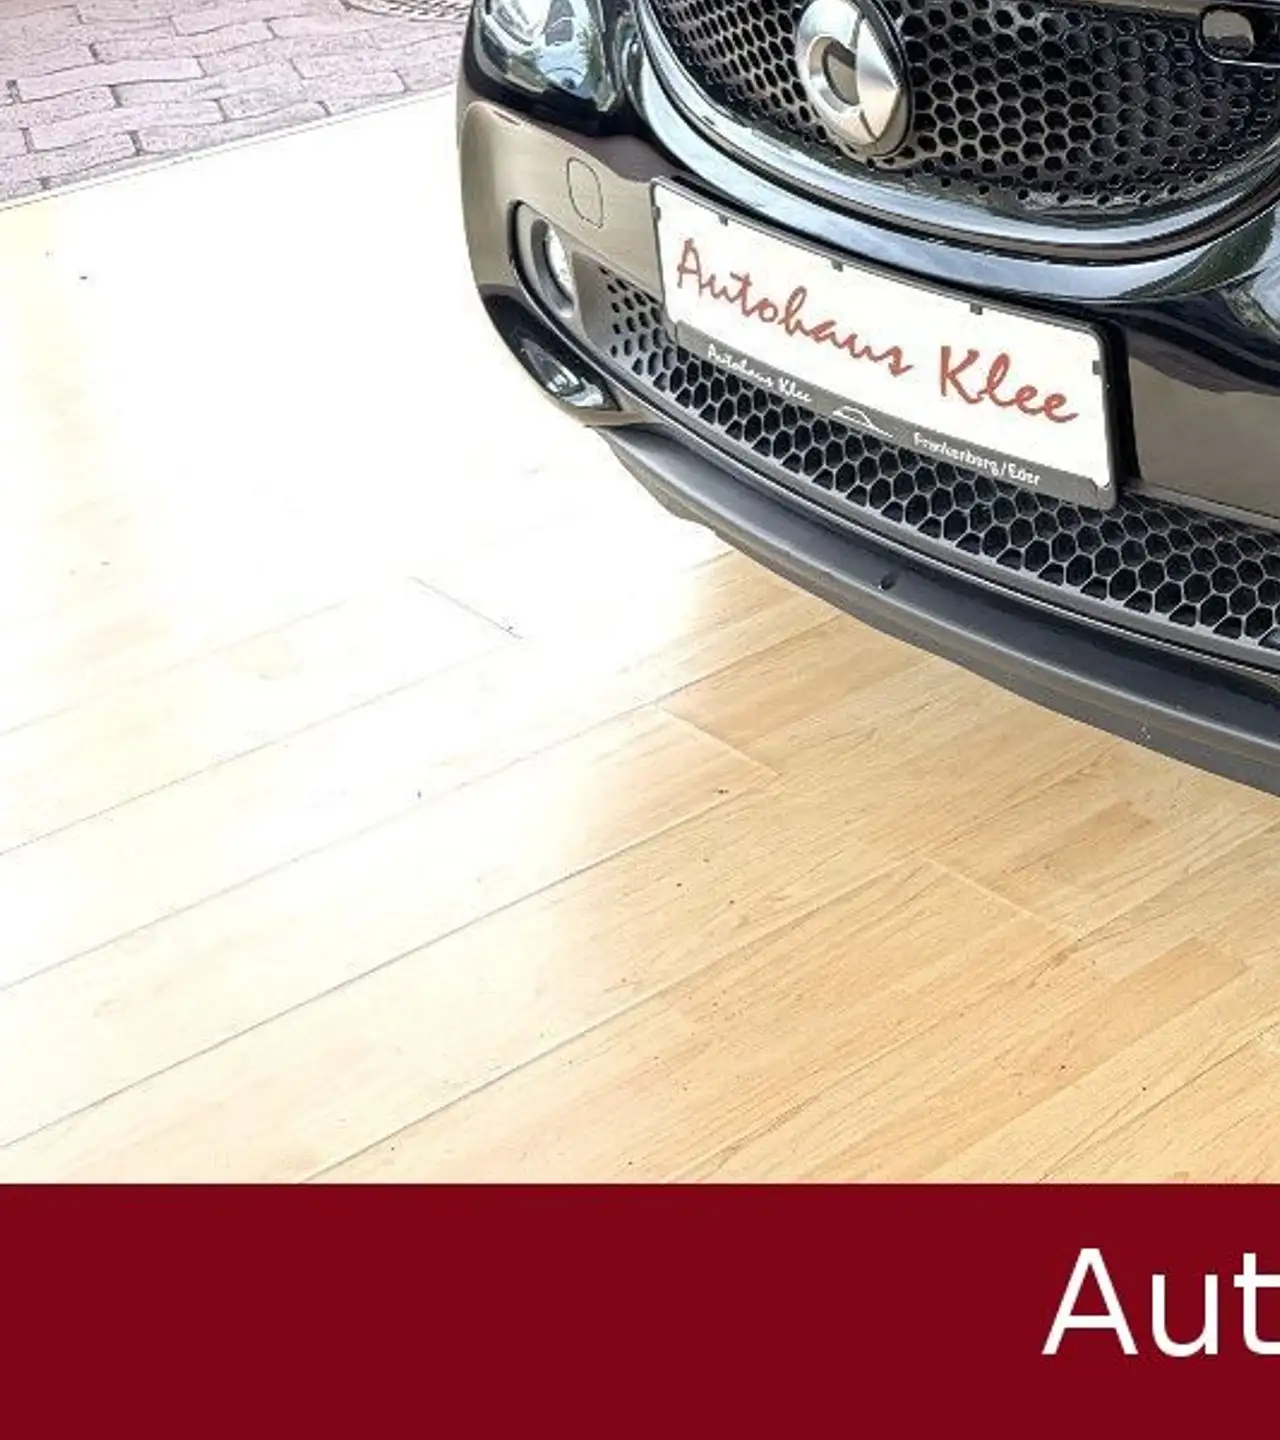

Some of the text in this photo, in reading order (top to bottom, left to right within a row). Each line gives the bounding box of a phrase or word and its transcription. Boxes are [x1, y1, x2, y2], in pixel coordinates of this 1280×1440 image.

[675, 237, 1080, 425] Autohaus Klee
[707, 342, 814, 404] Autohaus Klee
